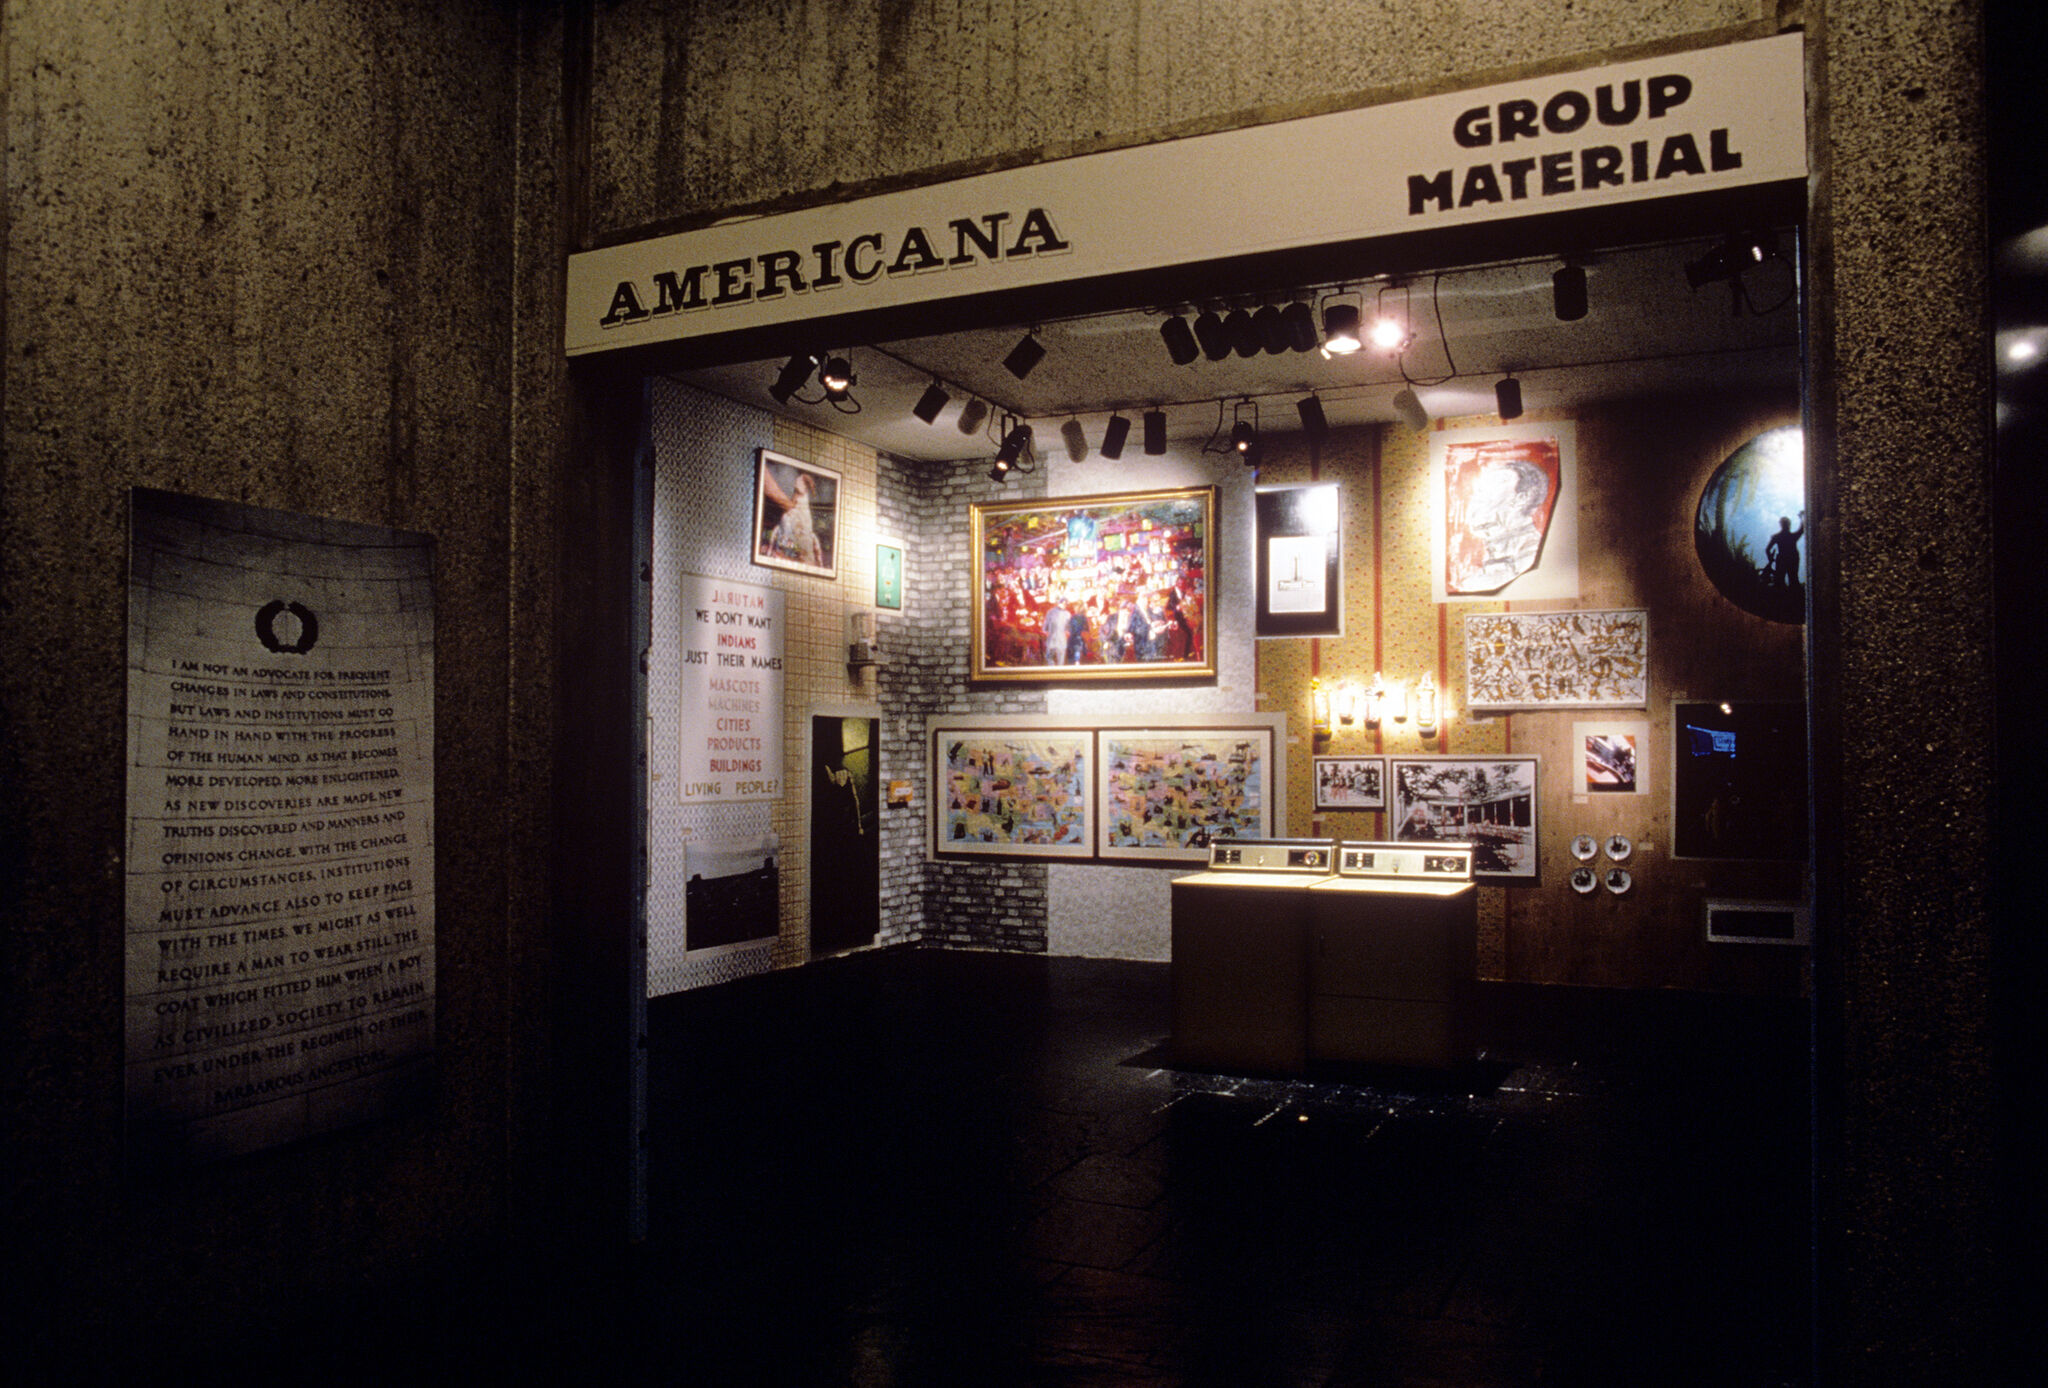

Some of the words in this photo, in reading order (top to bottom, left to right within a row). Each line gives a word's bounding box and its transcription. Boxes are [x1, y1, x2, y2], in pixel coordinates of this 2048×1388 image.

[1454, 74, 1692, 148] GROUP
[1407, 128, 1742, 216] MATERIAL
[600, 208, 1071, 329] AMERICANA
[695, 608, 709, 624] WE
[716, 611, 743, 626] DON'T
[747, 615, 772, 630] WANT
[717, 633, 757, 650] INDIANS
[180, 661, 199, 671] AM
[203, 663, 228, 675] NOT
[233, 667, 248, 676] AN
[252, 668, 310, 680] ADVOCATE
[314, 670, 335, 680] FOR
[338, 669, 390, 680] FREQUENT
[684, 649, 708, 665] JUST
[716, 652, 745, 668] THEIR
[751, 655, 782, 670] NAMES
[171, 681, 229, 696] CHANGES
[234, 688, 247, 697] IN
[251, 689, 278, 699] LAWS
[281, 690, 305, 700] AND
[709, 678, 761, 694] MASCOTS
[170, 704, 195, 715] BUT
[199, 706, 230, 718] LAWS
[234, 709, 261, 719] AND
[265, 710, 343, 720] INSTITUTIONS
[347, 709, 375, 718] MUST
[709, 697, 760, 713] MACHINES
[168, 726, 209, 740] HAND
[214, 730, 228, 740] IN
[235, 730, 272, 742] HAND
[276, 731, 307, 741] WITH
[311, 731, 333, 740] THE
[339, 728, 396, 740] PROGRESS
[716, 718, 751, 732] CITIES
[707, 737, 761, 751] PRODUCTS
[167, 750, 185, 762] OF
[188, 751, 212, 763] THE
[218, 753, 263, 764] HUMAN
[306, 753, 319, 762] AS
[321, 751, 347, 761] THAT
[351, 747, 398, 760] BECOMES
[710, 759, 762, 773] BUILDINGS
[166, 775, 203, 787] MORE
[286, 775, 317, 786] MORE
[685, 782, 721, 797] LIVING
[735, 779, 779, 795] PEOPLE?
[164, 800, 181, 811] AS
[188, 800, 220, 812] NEW
[224, 798, 311, 811] DISCOVERIES
[317, 795, 339, 807] ARE
[379, 788, 402, 800] NEW
[163, 825, 214, 838] TRUTHS
[219, 822, 297, 837] DISCOVERED
[301, 820, 325, 832] AND
[327, 814, 380, 830] MANNERS
[383, 810, 405, 823] AND
[162, 852, 233, 865] OPINIONS
[298, 844, 330, 856] WITH
[334, 841, 357, 852] THE
[361, 833, 407, 849] CHANGE
[161, 880, 182, 893] OF
[320, 857, 410, 879] INSTITUTIONS
[158, 907, 204, 923] MUST
[210, 900, 280, 918] ADVANCE
[285, 895, 321, 910] ALSO
[325, 892, 343, 905] TO
[348, 886, 379, 900] KEEP
[384, 879, 413, 895] PACE
[158, 937, 200, 952] WITH
[207, 932, 237, 948] THE
[292, 923, 312, 935] WE
[319, 914, 363, 932] MIGHT
[367, 911, 380, 924] AS
[385, 904, 417, 919] WELL
[158, 962, 231, 983] REQUIRE
[237, 961, 247, 973] A
[251, 955, 284, 971] MAN
[289, 951, 309, 964] TO
[314, 943, 353, 959] WEAR
[356, 936, 391, 952] STILL
[393, 929, 419, 944] THE
[155, 997, 200, 1015] COAT
[205, 989, 258, 1007] WHICH
[263, 979, 311, 999] FITTED
[316, 973, 342, 988] HIM
[345, 962, 383, 981] WHEN
[387, 962, 396, 975] A
[398, 953, 421, 971] BOY
[154, 1033, 175, 1050] AS
[182, 1016, 271, 1044] CIVILIZED
[277, 1001, 342, 1027] SOCIETY
[347, 996, 367, 1011] TO
[373, 981, 424, 1004] REMAIN
[154, 1063, 198, 1084] EVER
[203, 1050, 262, 1073] UNDER
[265, 1042, 294, 1059] THE
[301, 1026, 363, 1052] REGIMEN
[368, 1019, 385, 1034] OF
[389, 1010, 428, 1029] THEIR
[214, 1072, 304, 1104] BARBAROUS
